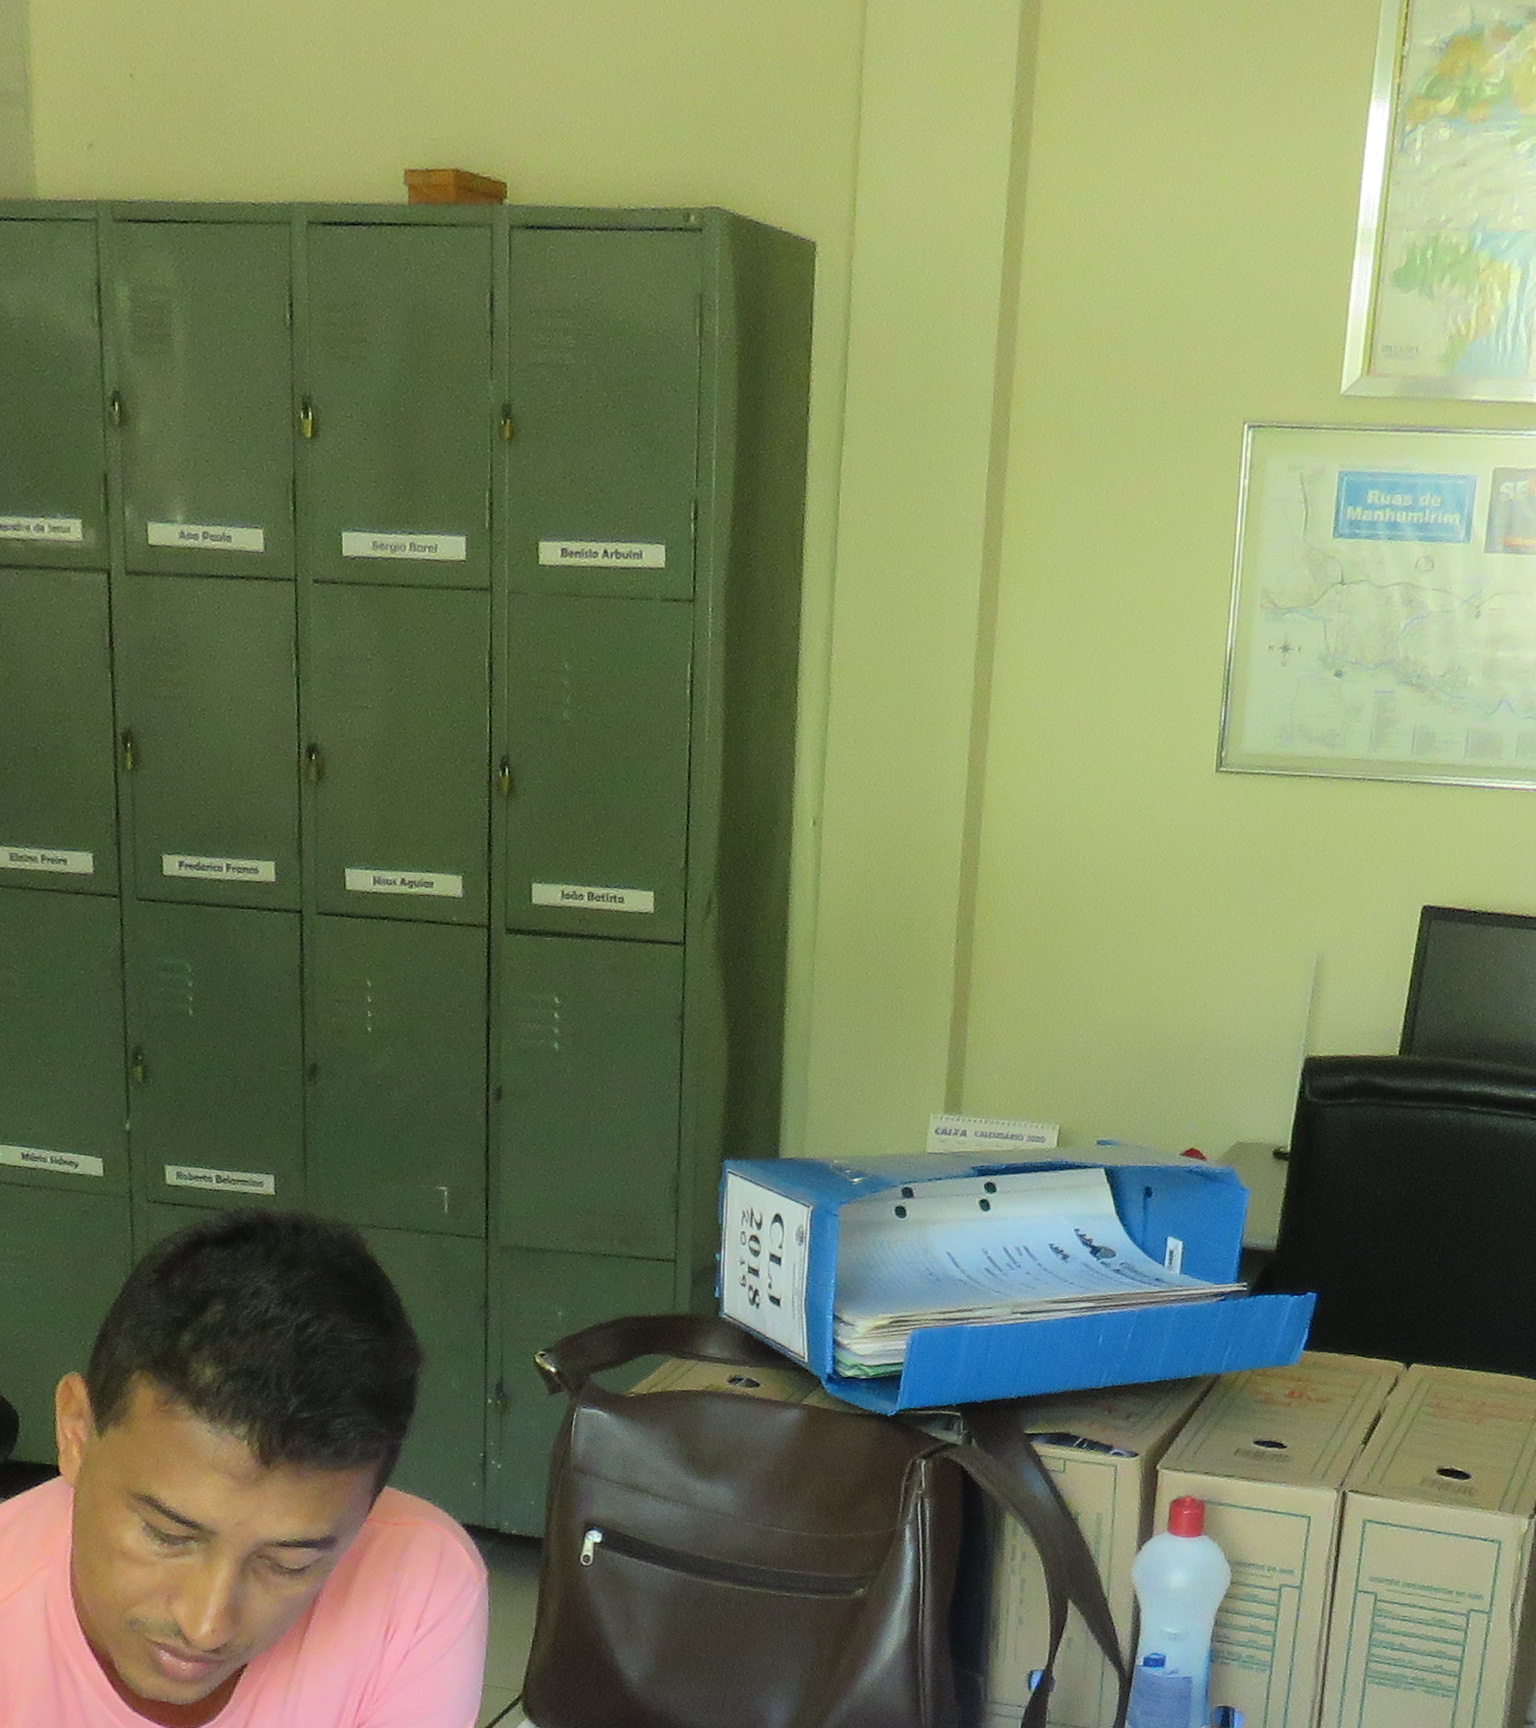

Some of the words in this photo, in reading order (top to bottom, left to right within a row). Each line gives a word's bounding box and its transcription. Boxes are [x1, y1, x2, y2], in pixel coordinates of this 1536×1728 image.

[1366, 489, 1414, 507] Ruas
[1420, 491, 1442, 508] de
[1347, 506, 1462, 526] Manhumirim
[202, 531, 232, 543] Paula
[561, 889, 584, 901] João
[586, 891, 625, 904] Batista
[934, 1126, 967, 1138] CAIXA
[747, 1207, 763, 1310] 2018
